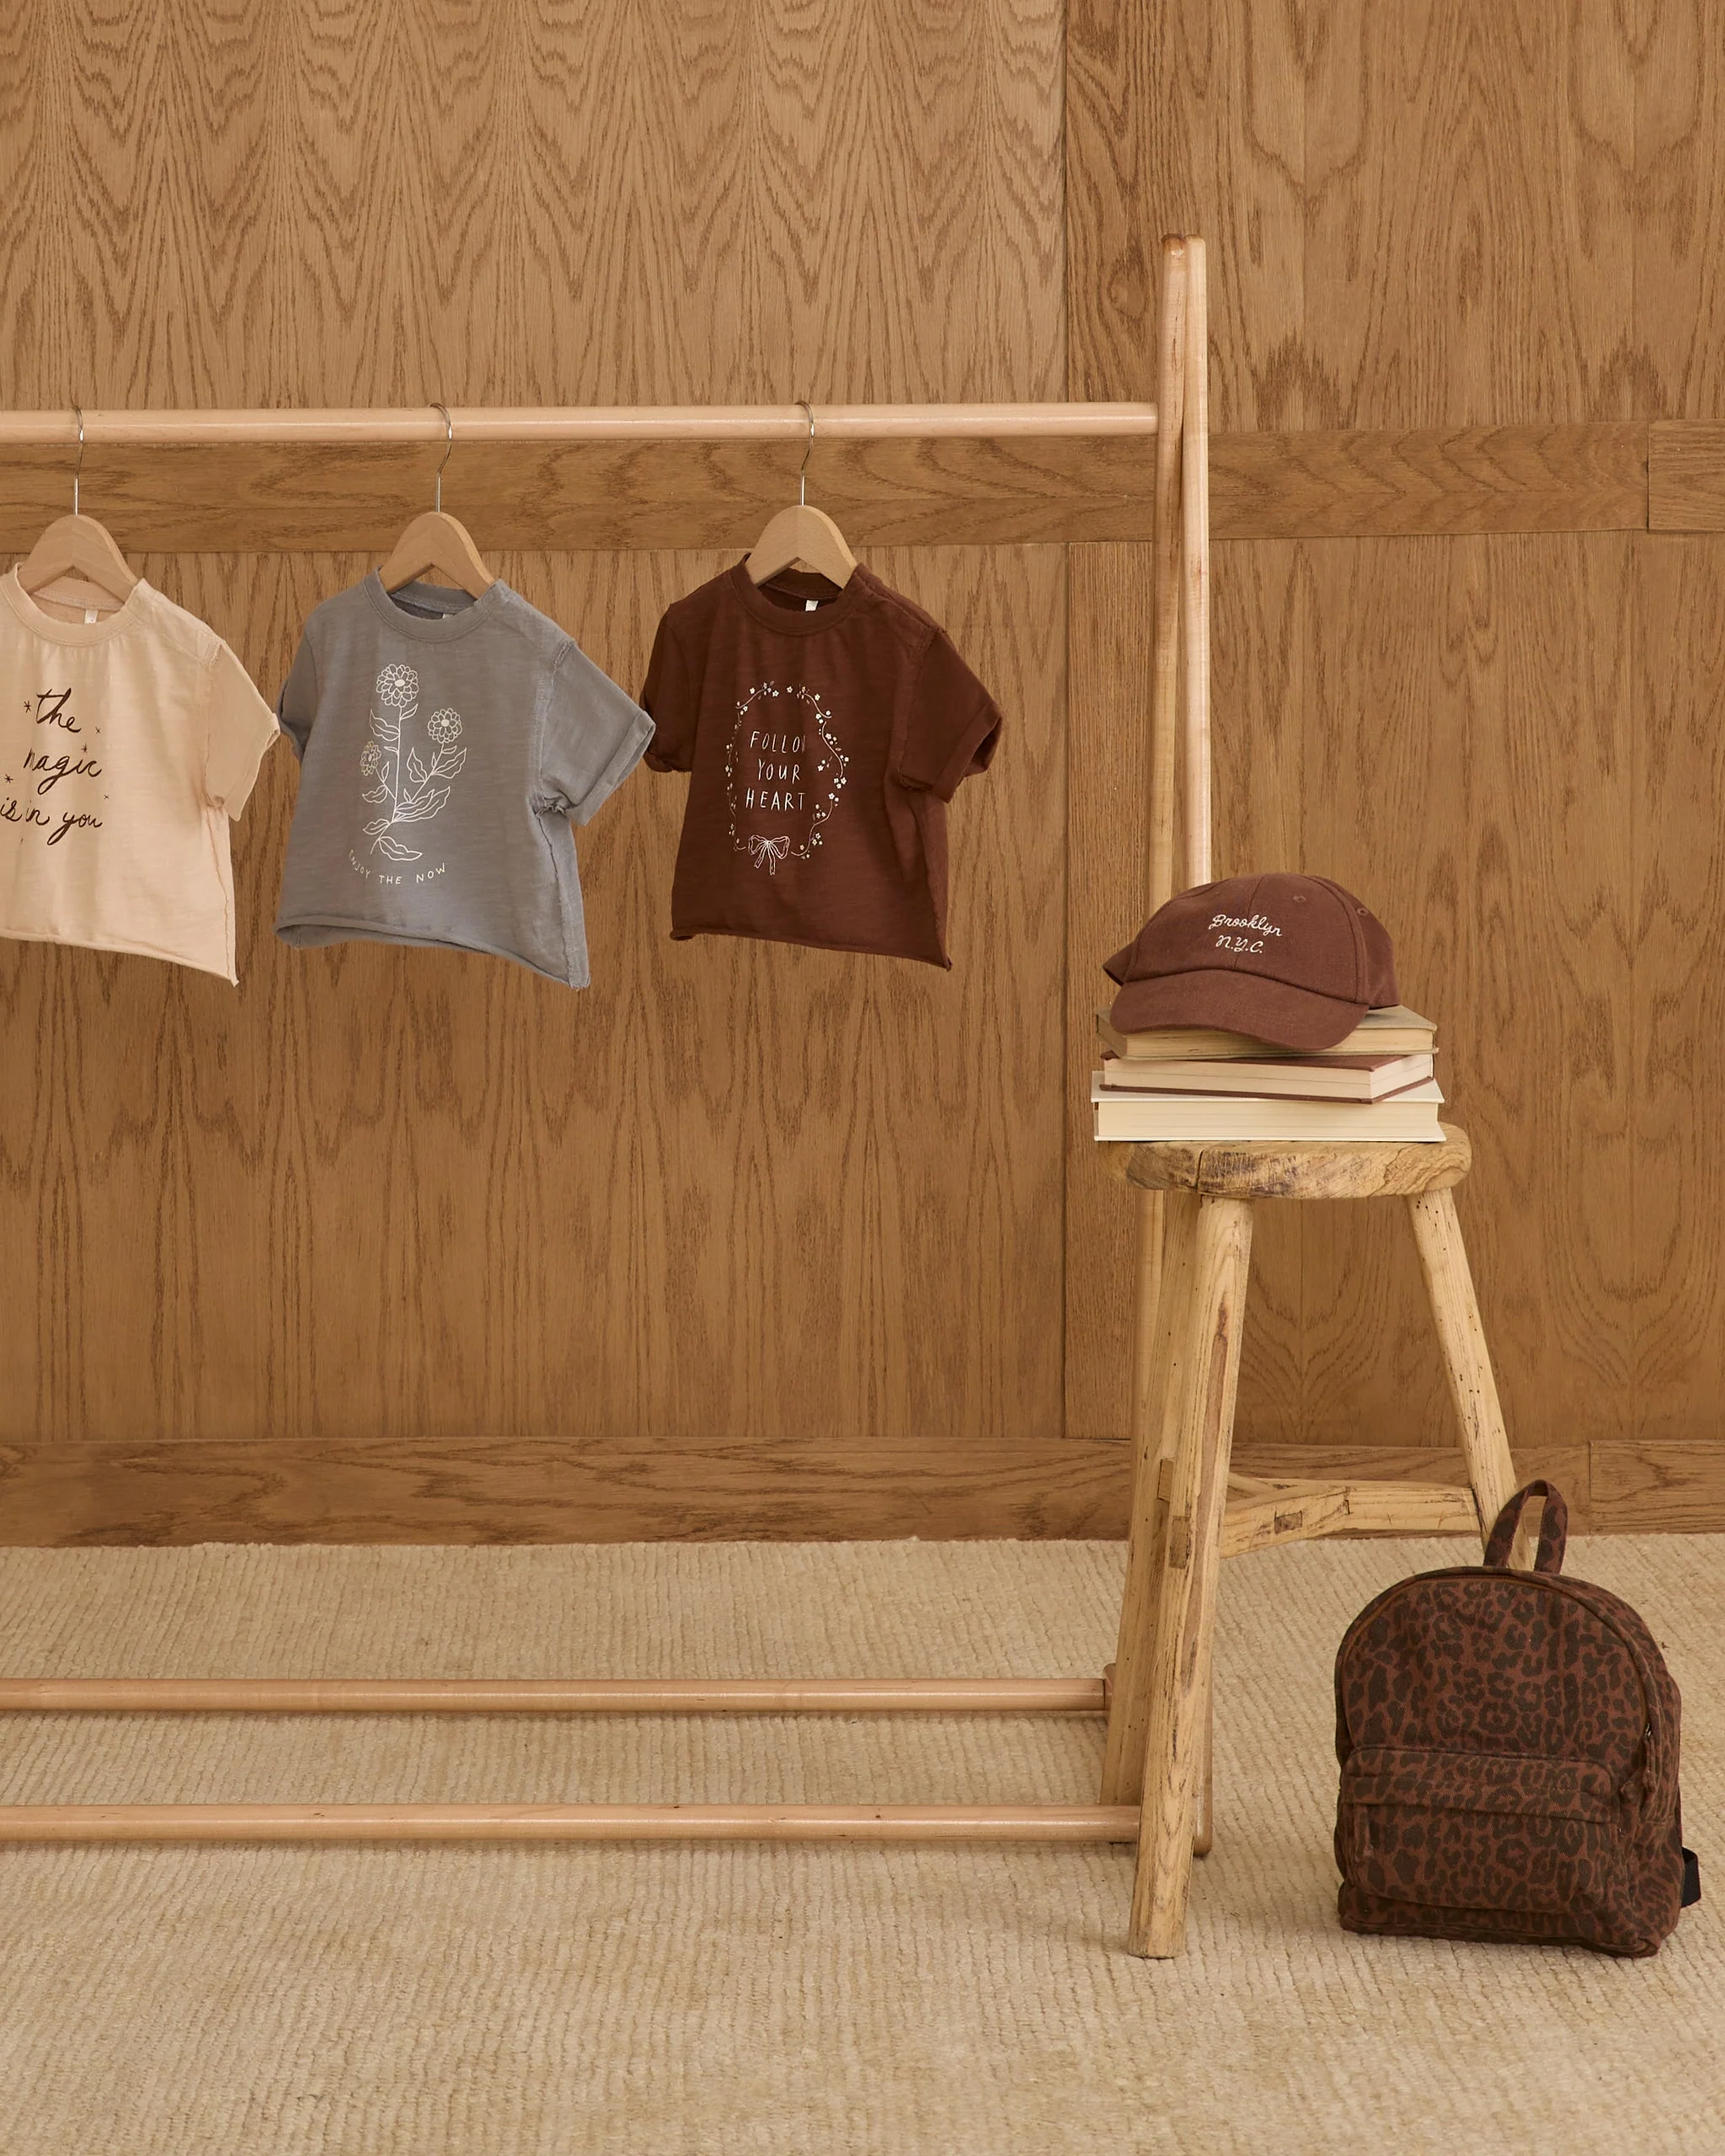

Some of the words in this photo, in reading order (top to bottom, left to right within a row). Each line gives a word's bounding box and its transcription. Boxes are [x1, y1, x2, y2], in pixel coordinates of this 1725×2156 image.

[35, 687, 82, 734] the
[758, 758, 801, 785] YOUR
[745, 787, 806, 812] HEART
[0, 797, 23, 822] is
[46, 812, 104, 846] you
[378, 875, 403, 885] THE
[416, 862, 446, 883] NOW
[1208, 914, 1283, 937] Brooklyn
[1215, 935, 1264, 954] N.Y.C.
